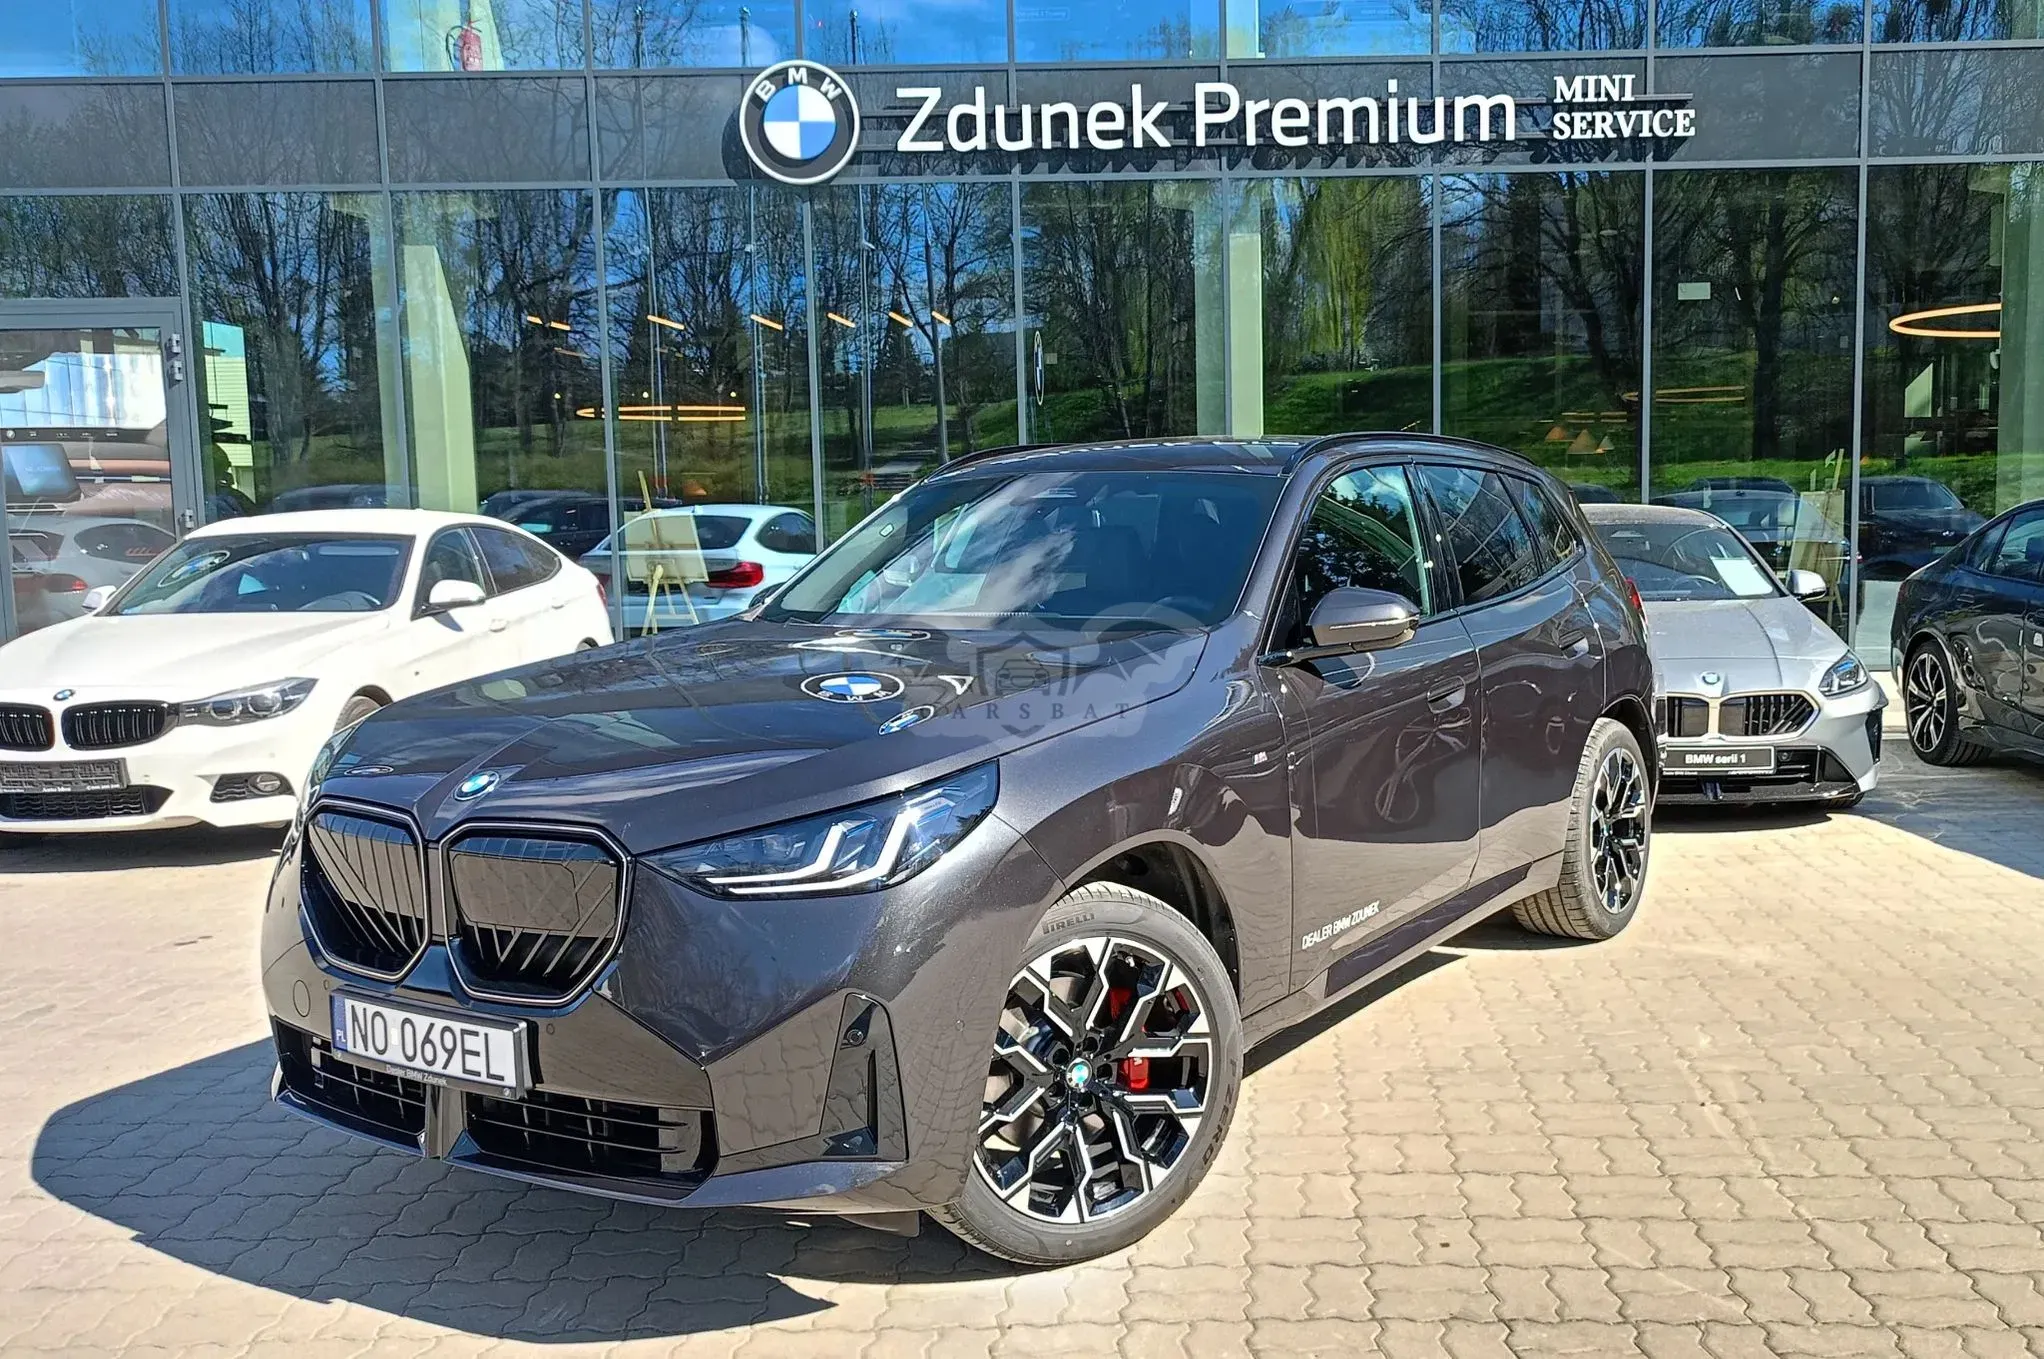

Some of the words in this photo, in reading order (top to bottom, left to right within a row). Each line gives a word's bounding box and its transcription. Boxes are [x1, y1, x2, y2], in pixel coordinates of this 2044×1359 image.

[755, 67, 842, 102] BMW
[1554, 74, 1637, 103] MINI
[896, 83, 1171, 152] Zdunek
[1194, 78, 1516, 147] Premium
[1553, 108, 1696, 140] SERVICE
[1685, 753, 1714, 764] BMW
[1715, 753, 1737, 764] serii
[1740, 753, 1747, 764] 1
[1042, 912, 1095, 935] PIRELLI
[1302, 924, 1333, 950] DEALER
[1333, 915, 1351, 935] BMW
[1351, 900, 1380, 926] ZDUNEK
[335, 1029, 346, 1042] PL
[351, 1004, 388, 1056] NO
[401, 1017, 505, 1082] 069EL
